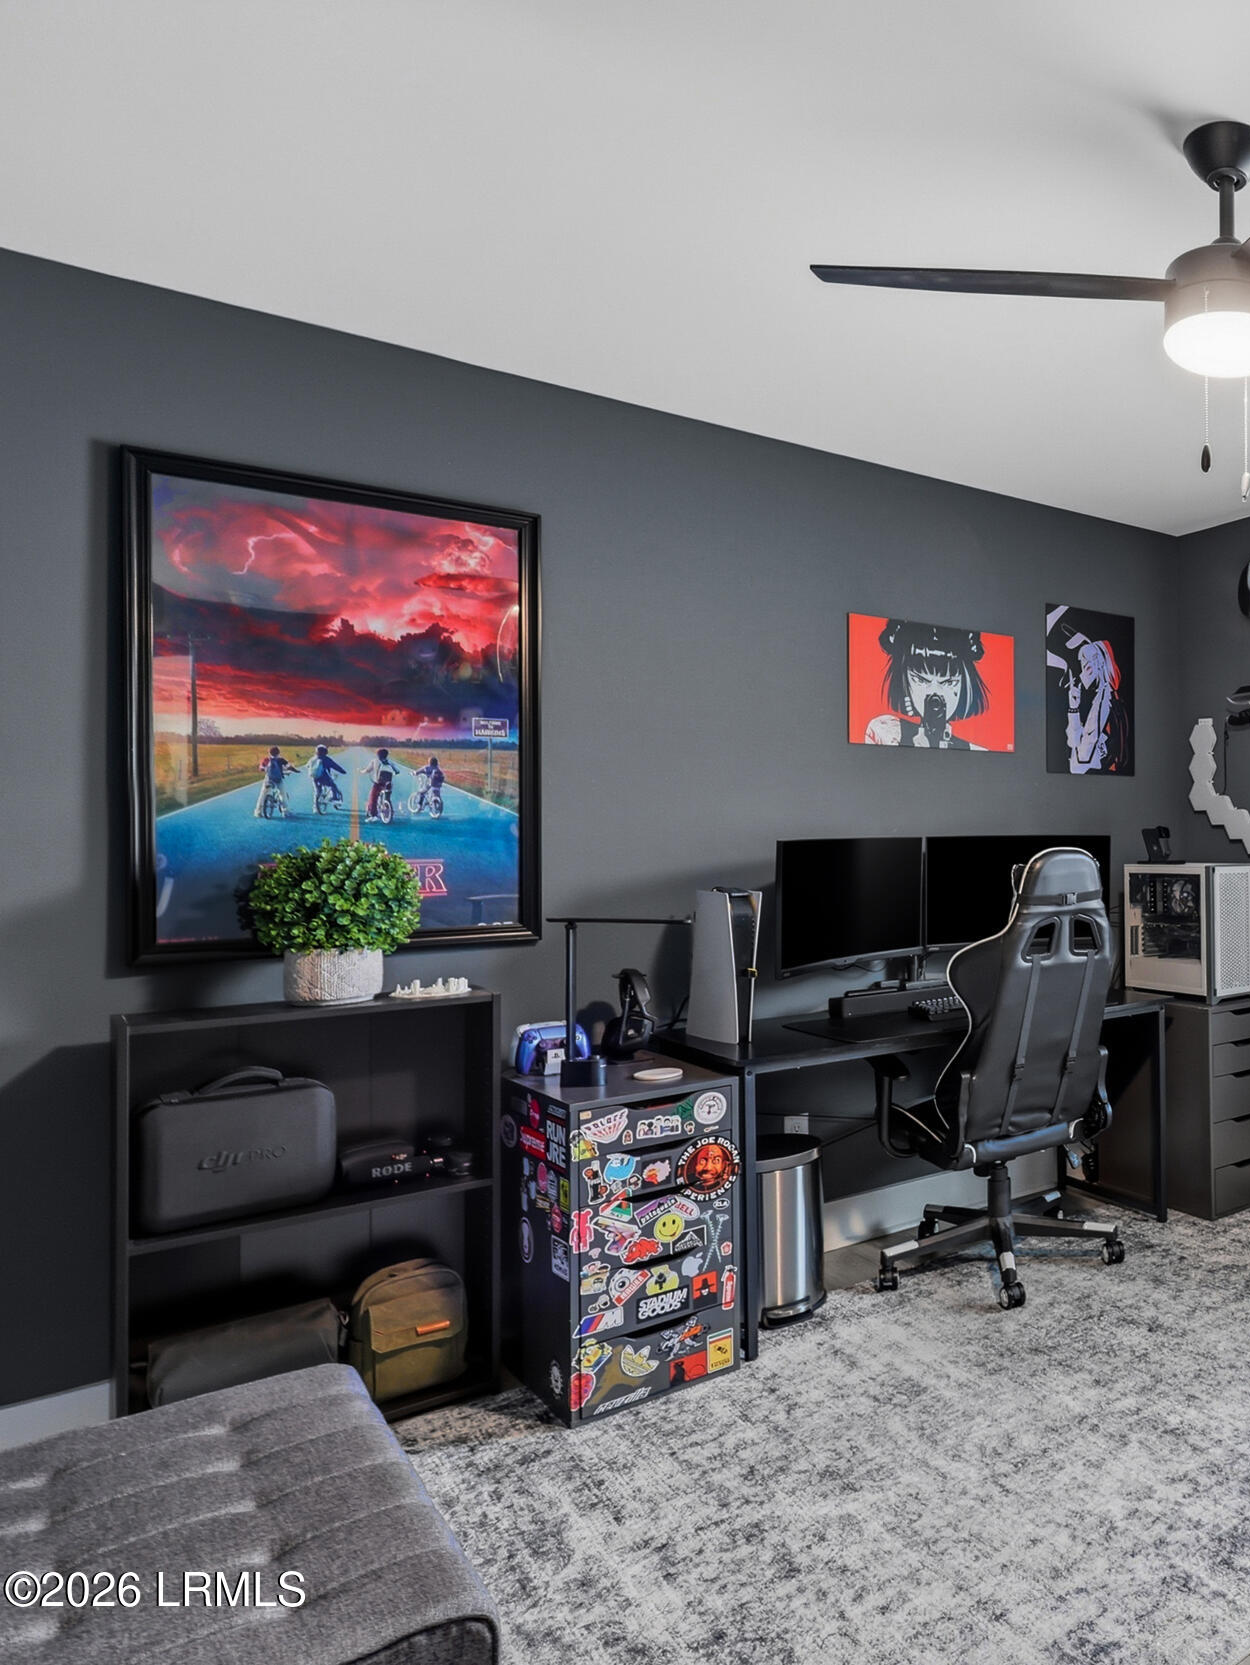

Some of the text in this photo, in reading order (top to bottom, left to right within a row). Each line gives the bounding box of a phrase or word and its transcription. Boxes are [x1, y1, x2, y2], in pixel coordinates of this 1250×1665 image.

[546, 1120, 566, 1147] RUN
[678, 1136, 740, 1166] THE JOE ROGAN
[676, 1175, 737, 1202] EPERIENCE
[638, 1301, 683, 1319] GOODS
[639, 1288, 688, 1310] STADIUM
